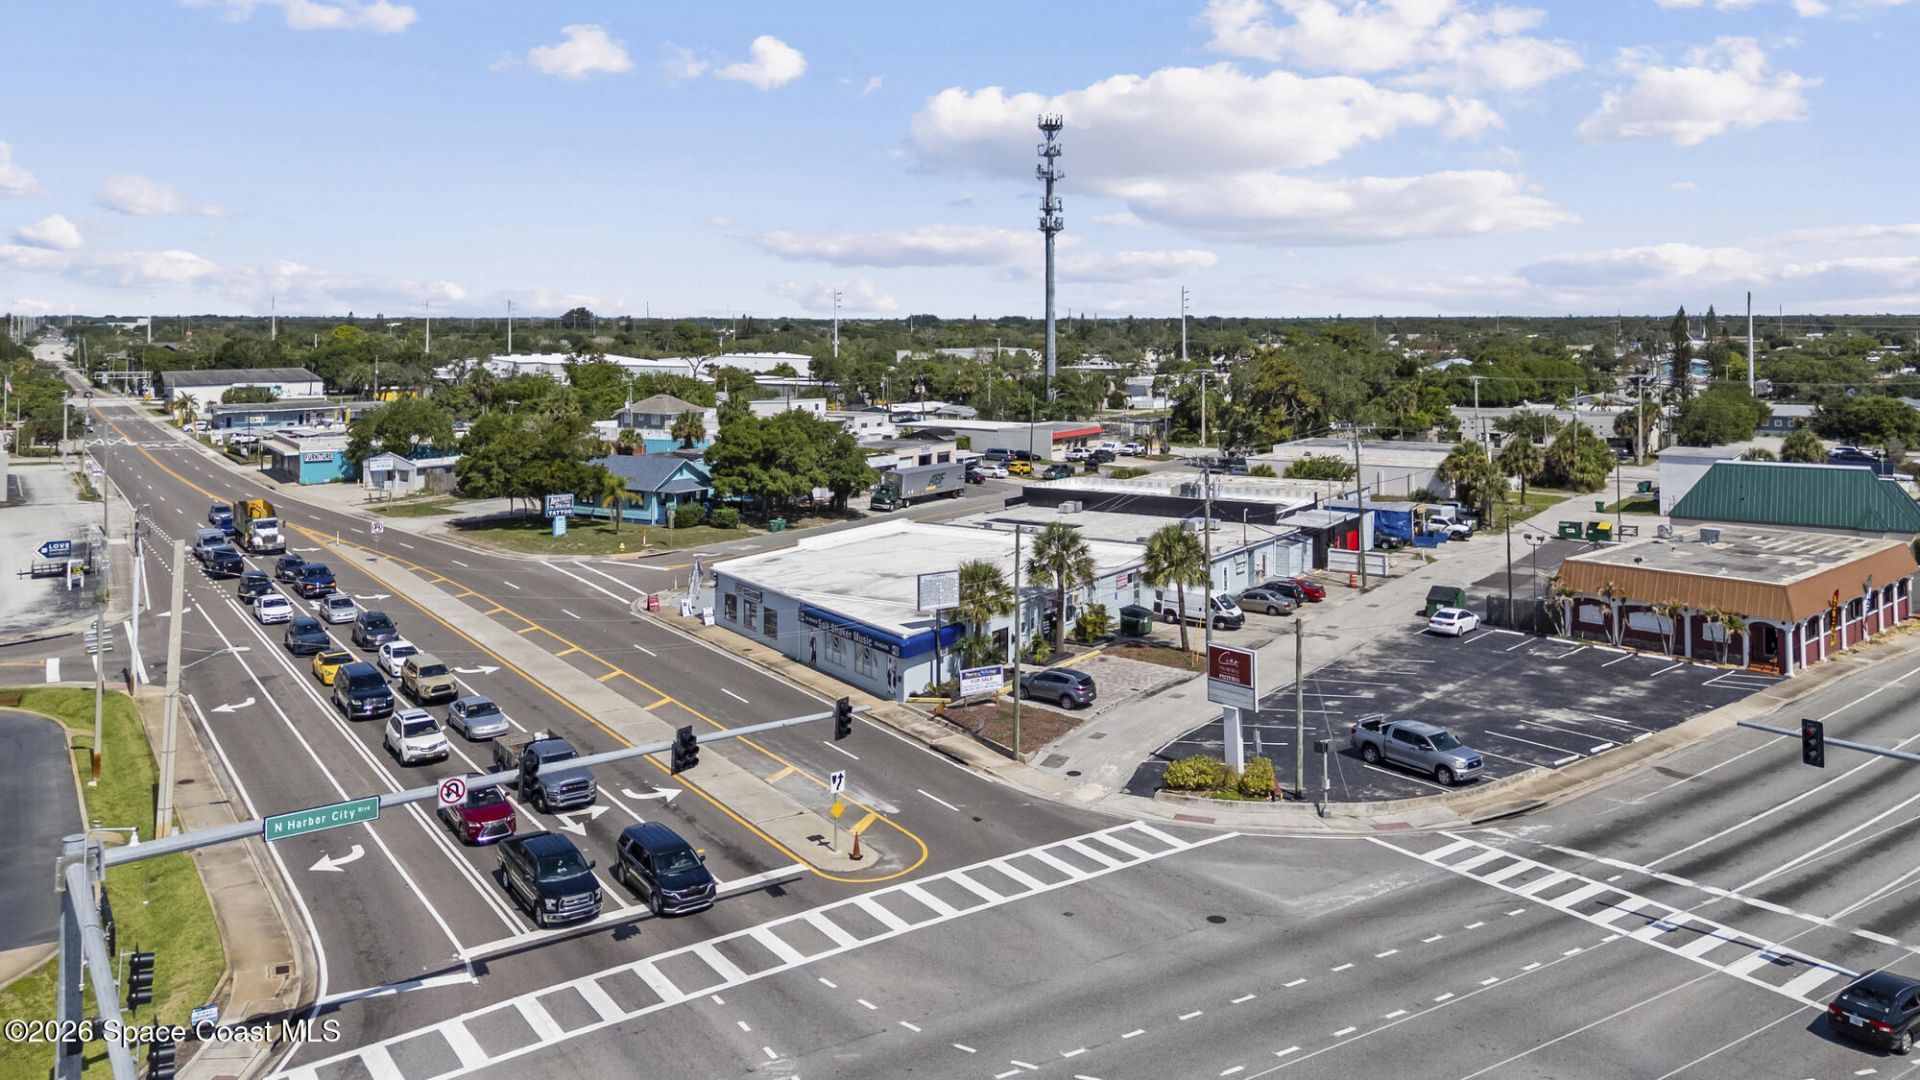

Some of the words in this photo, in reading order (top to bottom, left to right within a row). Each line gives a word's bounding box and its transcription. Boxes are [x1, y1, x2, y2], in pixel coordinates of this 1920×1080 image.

[304, 452, 332, 461] FURNITURE
[928, 472, 946, 486] ABF
[549, 509, 573, 517] TATTOO
[854, 631, 873, 647] Music
[274, 822, 283, 833] N
[287, 814, 326, 831] Harbor
[331, 808, 356, 820] City
[357, 805, 371, 813] Blvd
